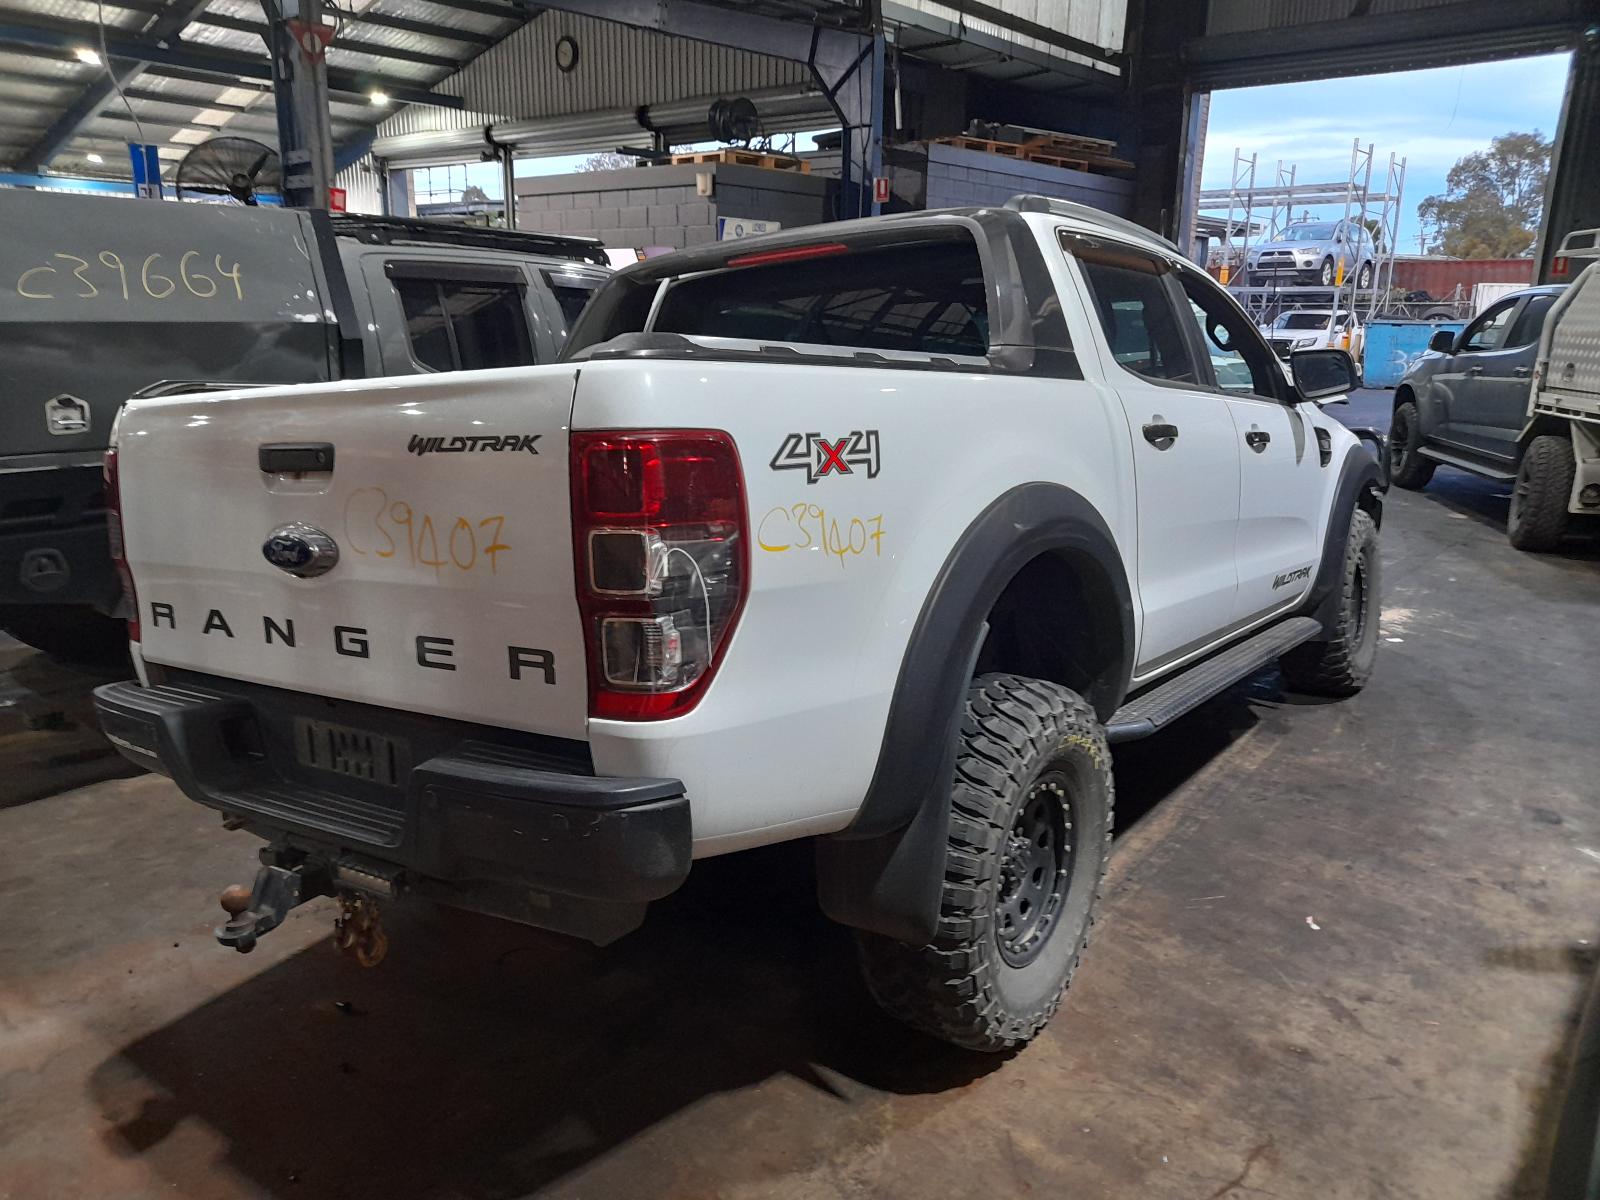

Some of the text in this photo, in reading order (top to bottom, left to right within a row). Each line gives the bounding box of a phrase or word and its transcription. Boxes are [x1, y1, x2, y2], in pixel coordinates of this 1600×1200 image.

[17, 250, 243, 300] C39664
[408, 434, 543, 456] WILDTRAK
[151, 602, 557, 685] RANGER
